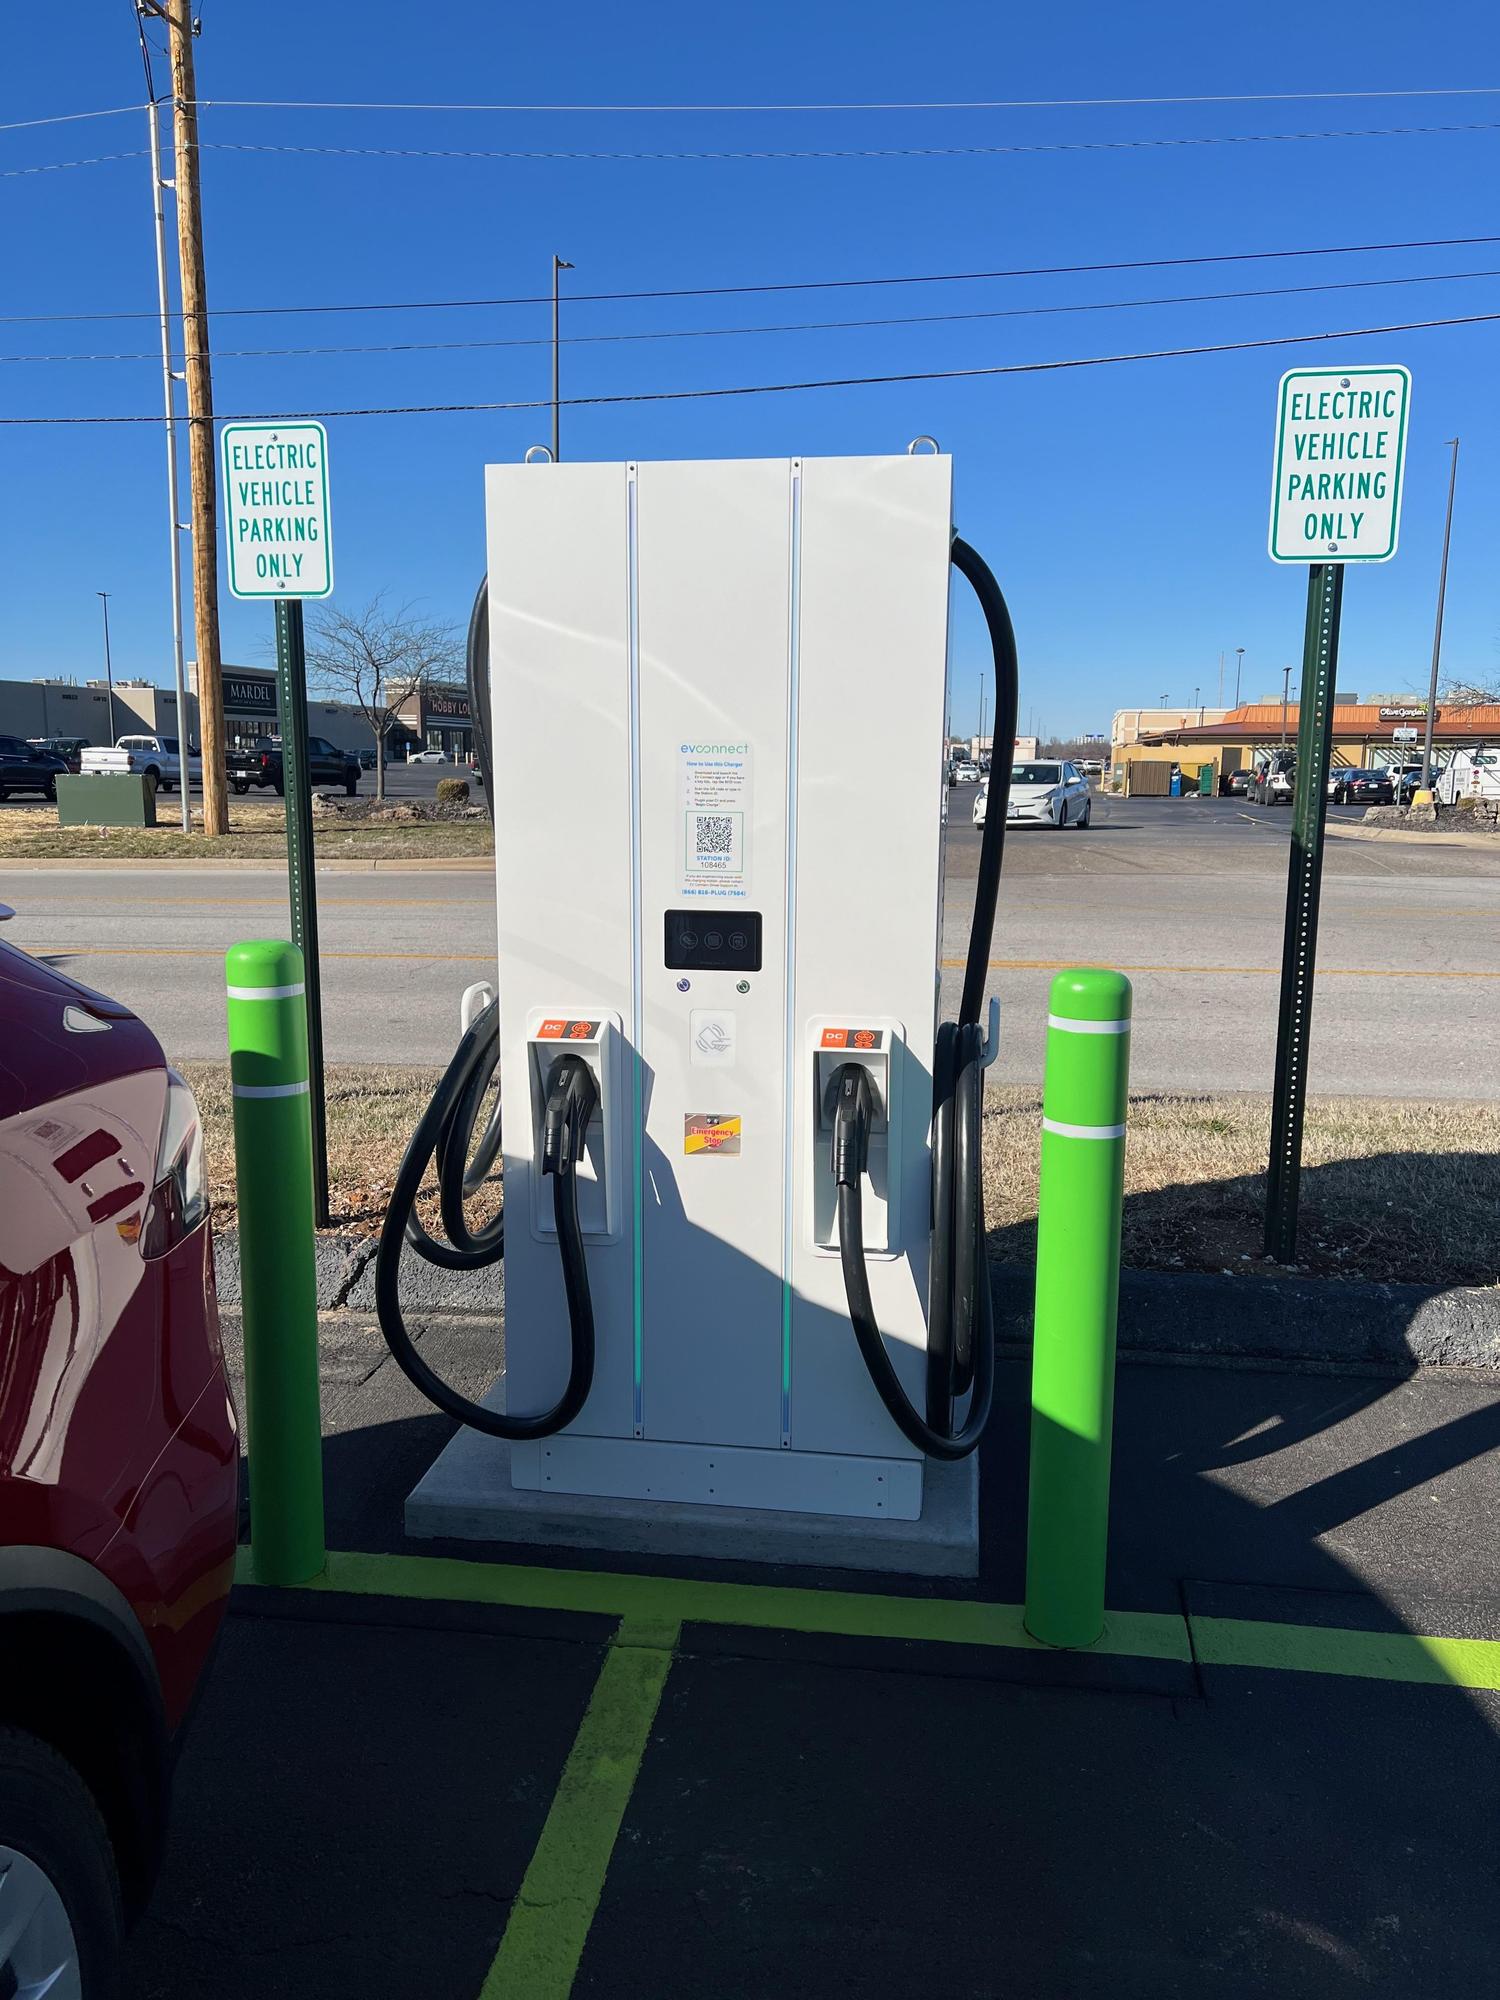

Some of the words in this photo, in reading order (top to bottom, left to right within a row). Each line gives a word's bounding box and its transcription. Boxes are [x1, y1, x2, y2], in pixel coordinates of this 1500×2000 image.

[1291, 389, 1396, 420] ELECTRIC
[232, 443, 317, 470] ELECTRIC
[1294, 431, 1388, 461] VEHICLE
[238, 480, 315, 506] VEHICLE
[1288, 471, 1387, 500] PARKING
[239, 517, 318, 542] PARKING
[1304, 512, 1365, 540] ONLY
[256, 553, 304, 578] ONLY
[231, 684, 270, 700] MARDEL
[432, 700, 457, 713] HOBBY
[680, 743, 749, 754] evconnect
[700, 861, 727, 869] 108465
[690, 1127, 734, 1136] Emergency
[703, 1135, 722, 1145] Stop
